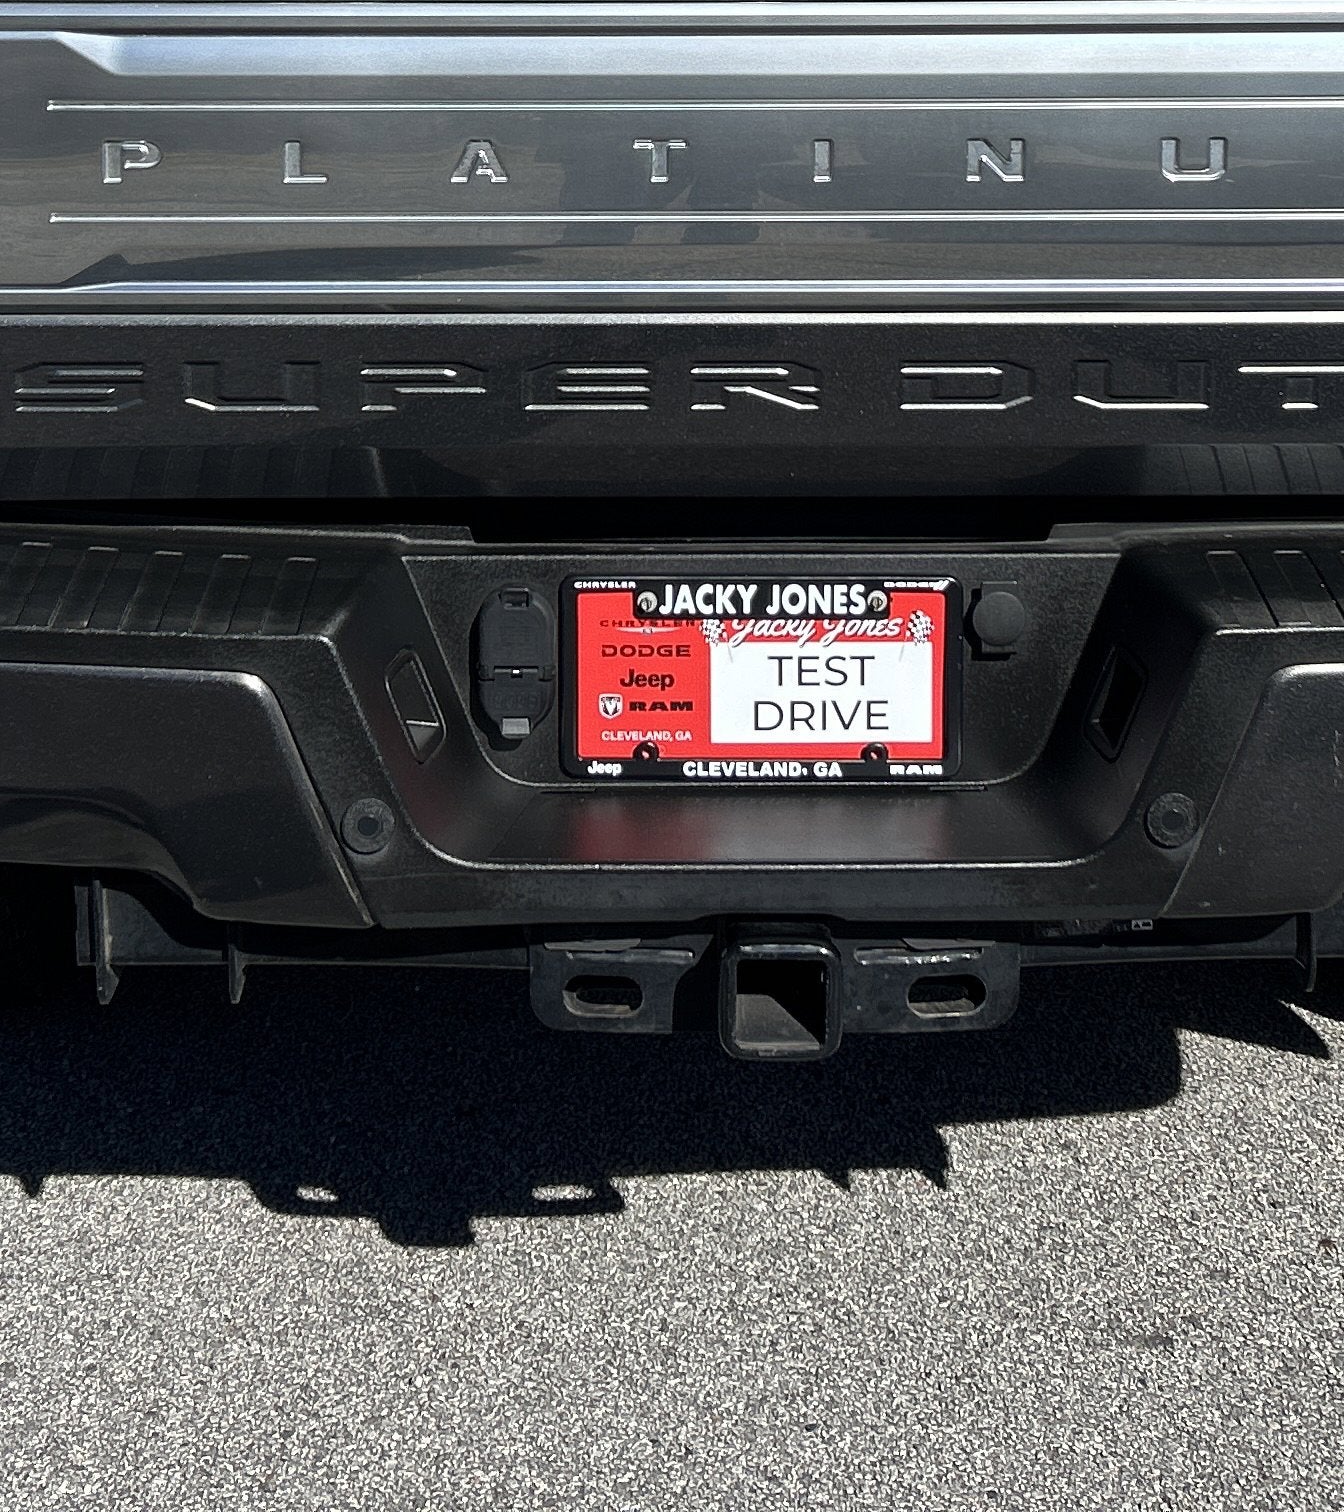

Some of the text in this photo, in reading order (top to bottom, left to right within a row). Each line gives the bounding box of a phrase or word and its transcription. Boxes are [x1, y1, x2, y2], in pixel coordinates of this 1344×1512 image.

[14, 361, 821, 413] SUPER
[573, 581, 636, 589] CHRYSLER
[658, 583, 867, 616] JACKY JONES
[728, 618, 905, 648] Jacky Jones
[601, 644, 692, 658] DODGE
[619, 668, 676, 691] Jeep
[767, 655, 876, 687] TEST
[629, 701, 694, 712] RAM
[753, 700, 890, 731] DRIVE
[601, 730, 693, 743] CLEVELAND, GA
[587, 760, 623, 777] Jeep
[812, 761, 843, 778] GA
[889, 764, 944, 775] RAM
